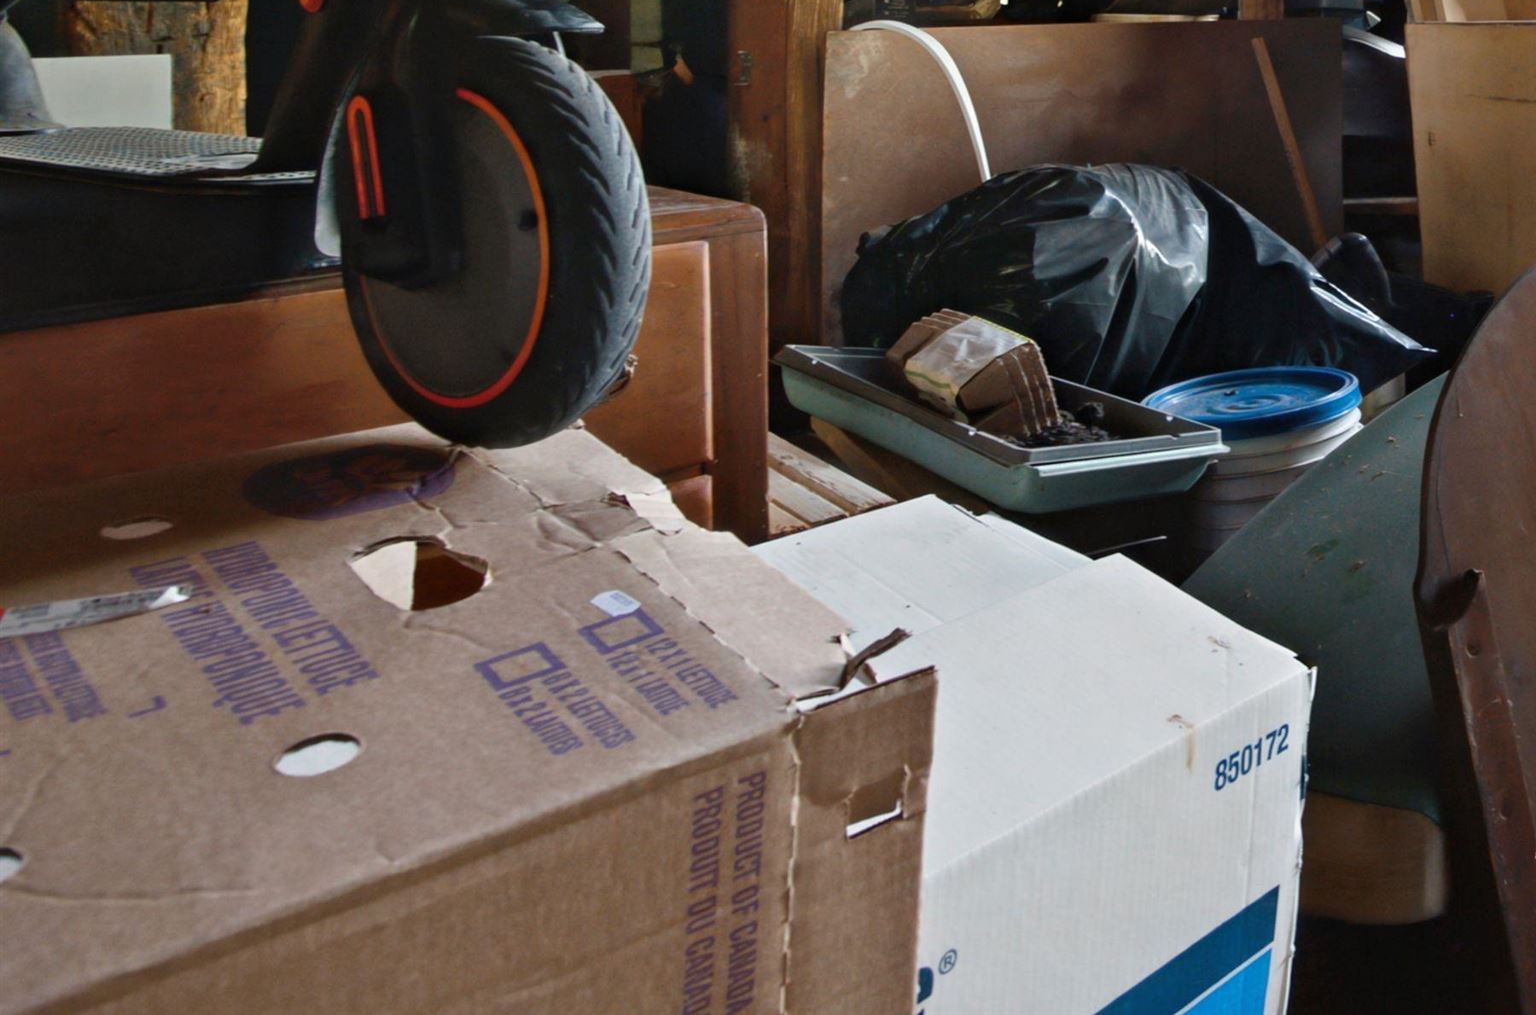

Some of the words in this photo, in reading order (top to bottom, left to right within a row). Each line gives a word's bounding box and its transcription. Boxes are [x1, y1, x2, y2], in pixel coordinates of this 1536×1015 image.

[272, 619, 380, 695] LETTUCE
[675, 664, 739, 709] LETTUCE
[1214, 723, 1289, 792] 850172
[689, 786, 724, 894] PRODUIT
[733, 770, 767, 882] PRODUCT
[685, 896, 717, 935] DU
[731, 885, 759, 915] OF
[682, 936, 716, 1015] CANAD
[725, 920, 758, 1015] CANADA
